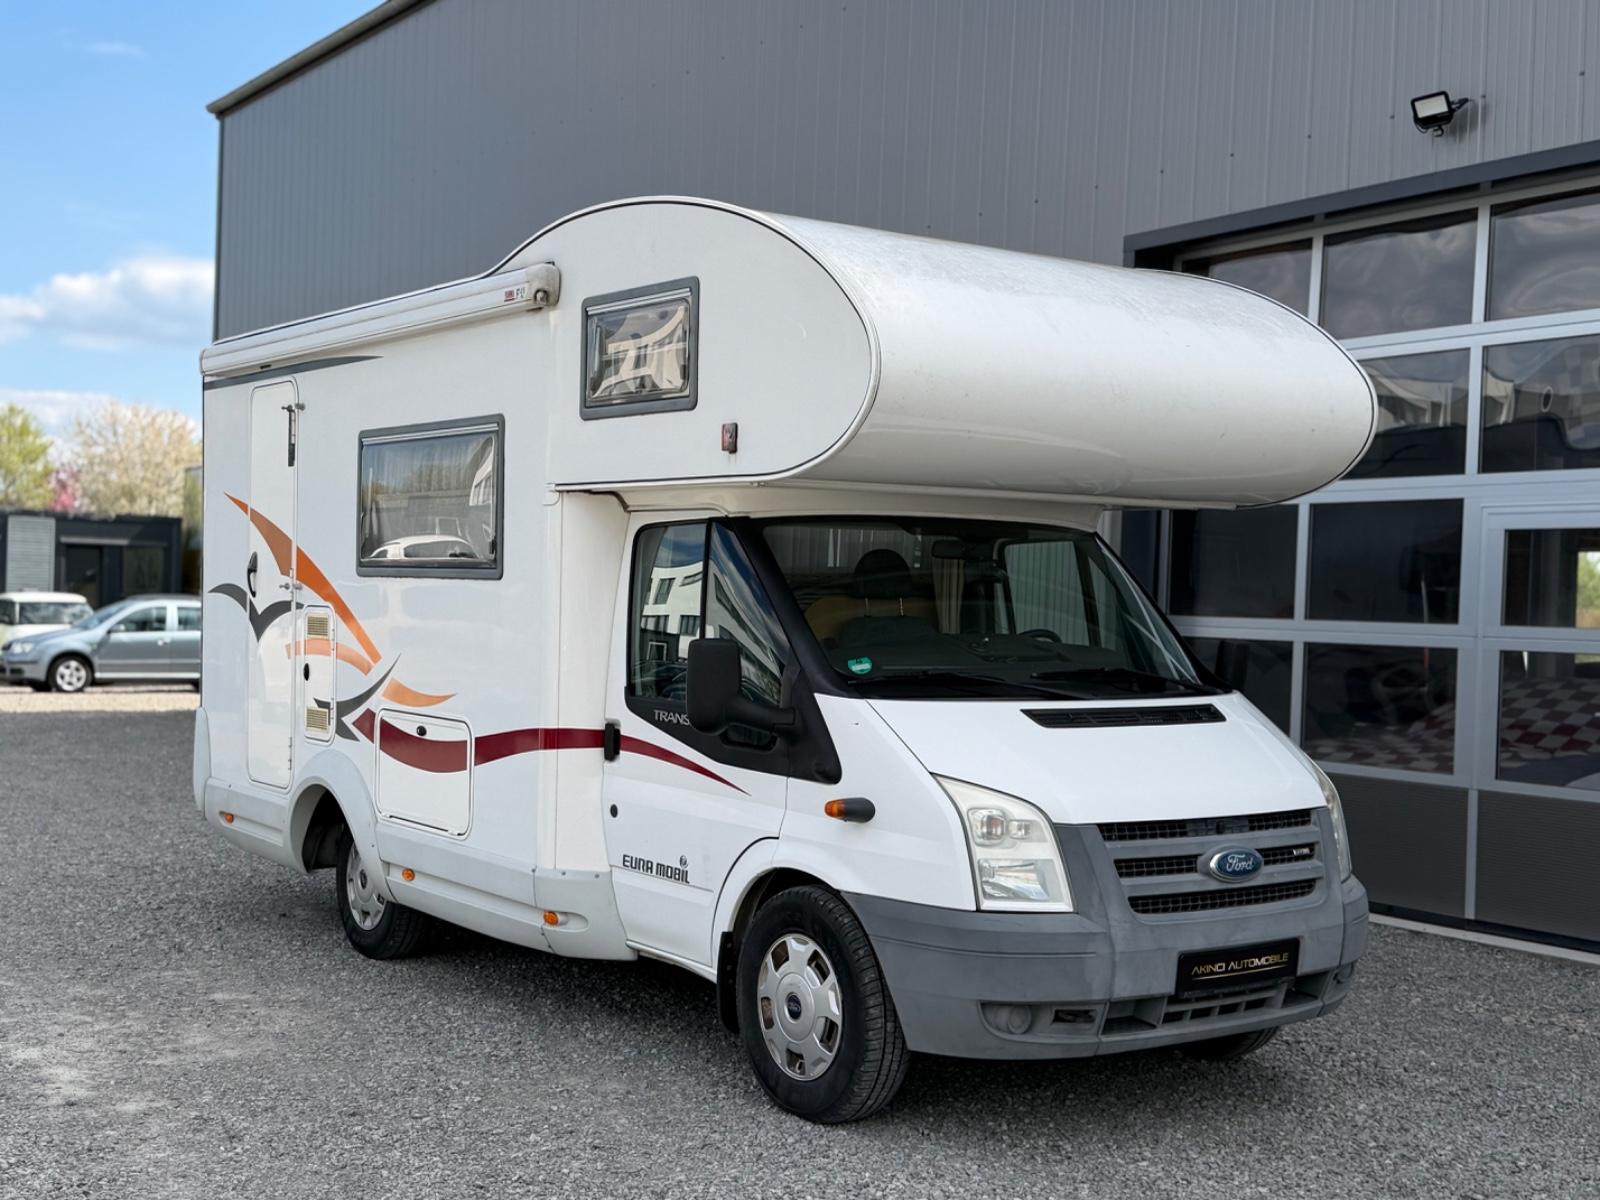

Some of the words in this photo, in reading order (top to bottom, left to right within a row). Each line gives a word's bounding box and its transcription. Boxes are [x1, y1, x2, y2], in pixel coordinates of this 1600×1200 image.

[622, 853, 654, 875] EURA
[656, 861, 690, 884] MOBIL
[1226, 853, 1254, 872] Ford
[1191, 962, 1226, 975] AKINCI
[1227, 952, 1289, 971] AUTOMOBILE
